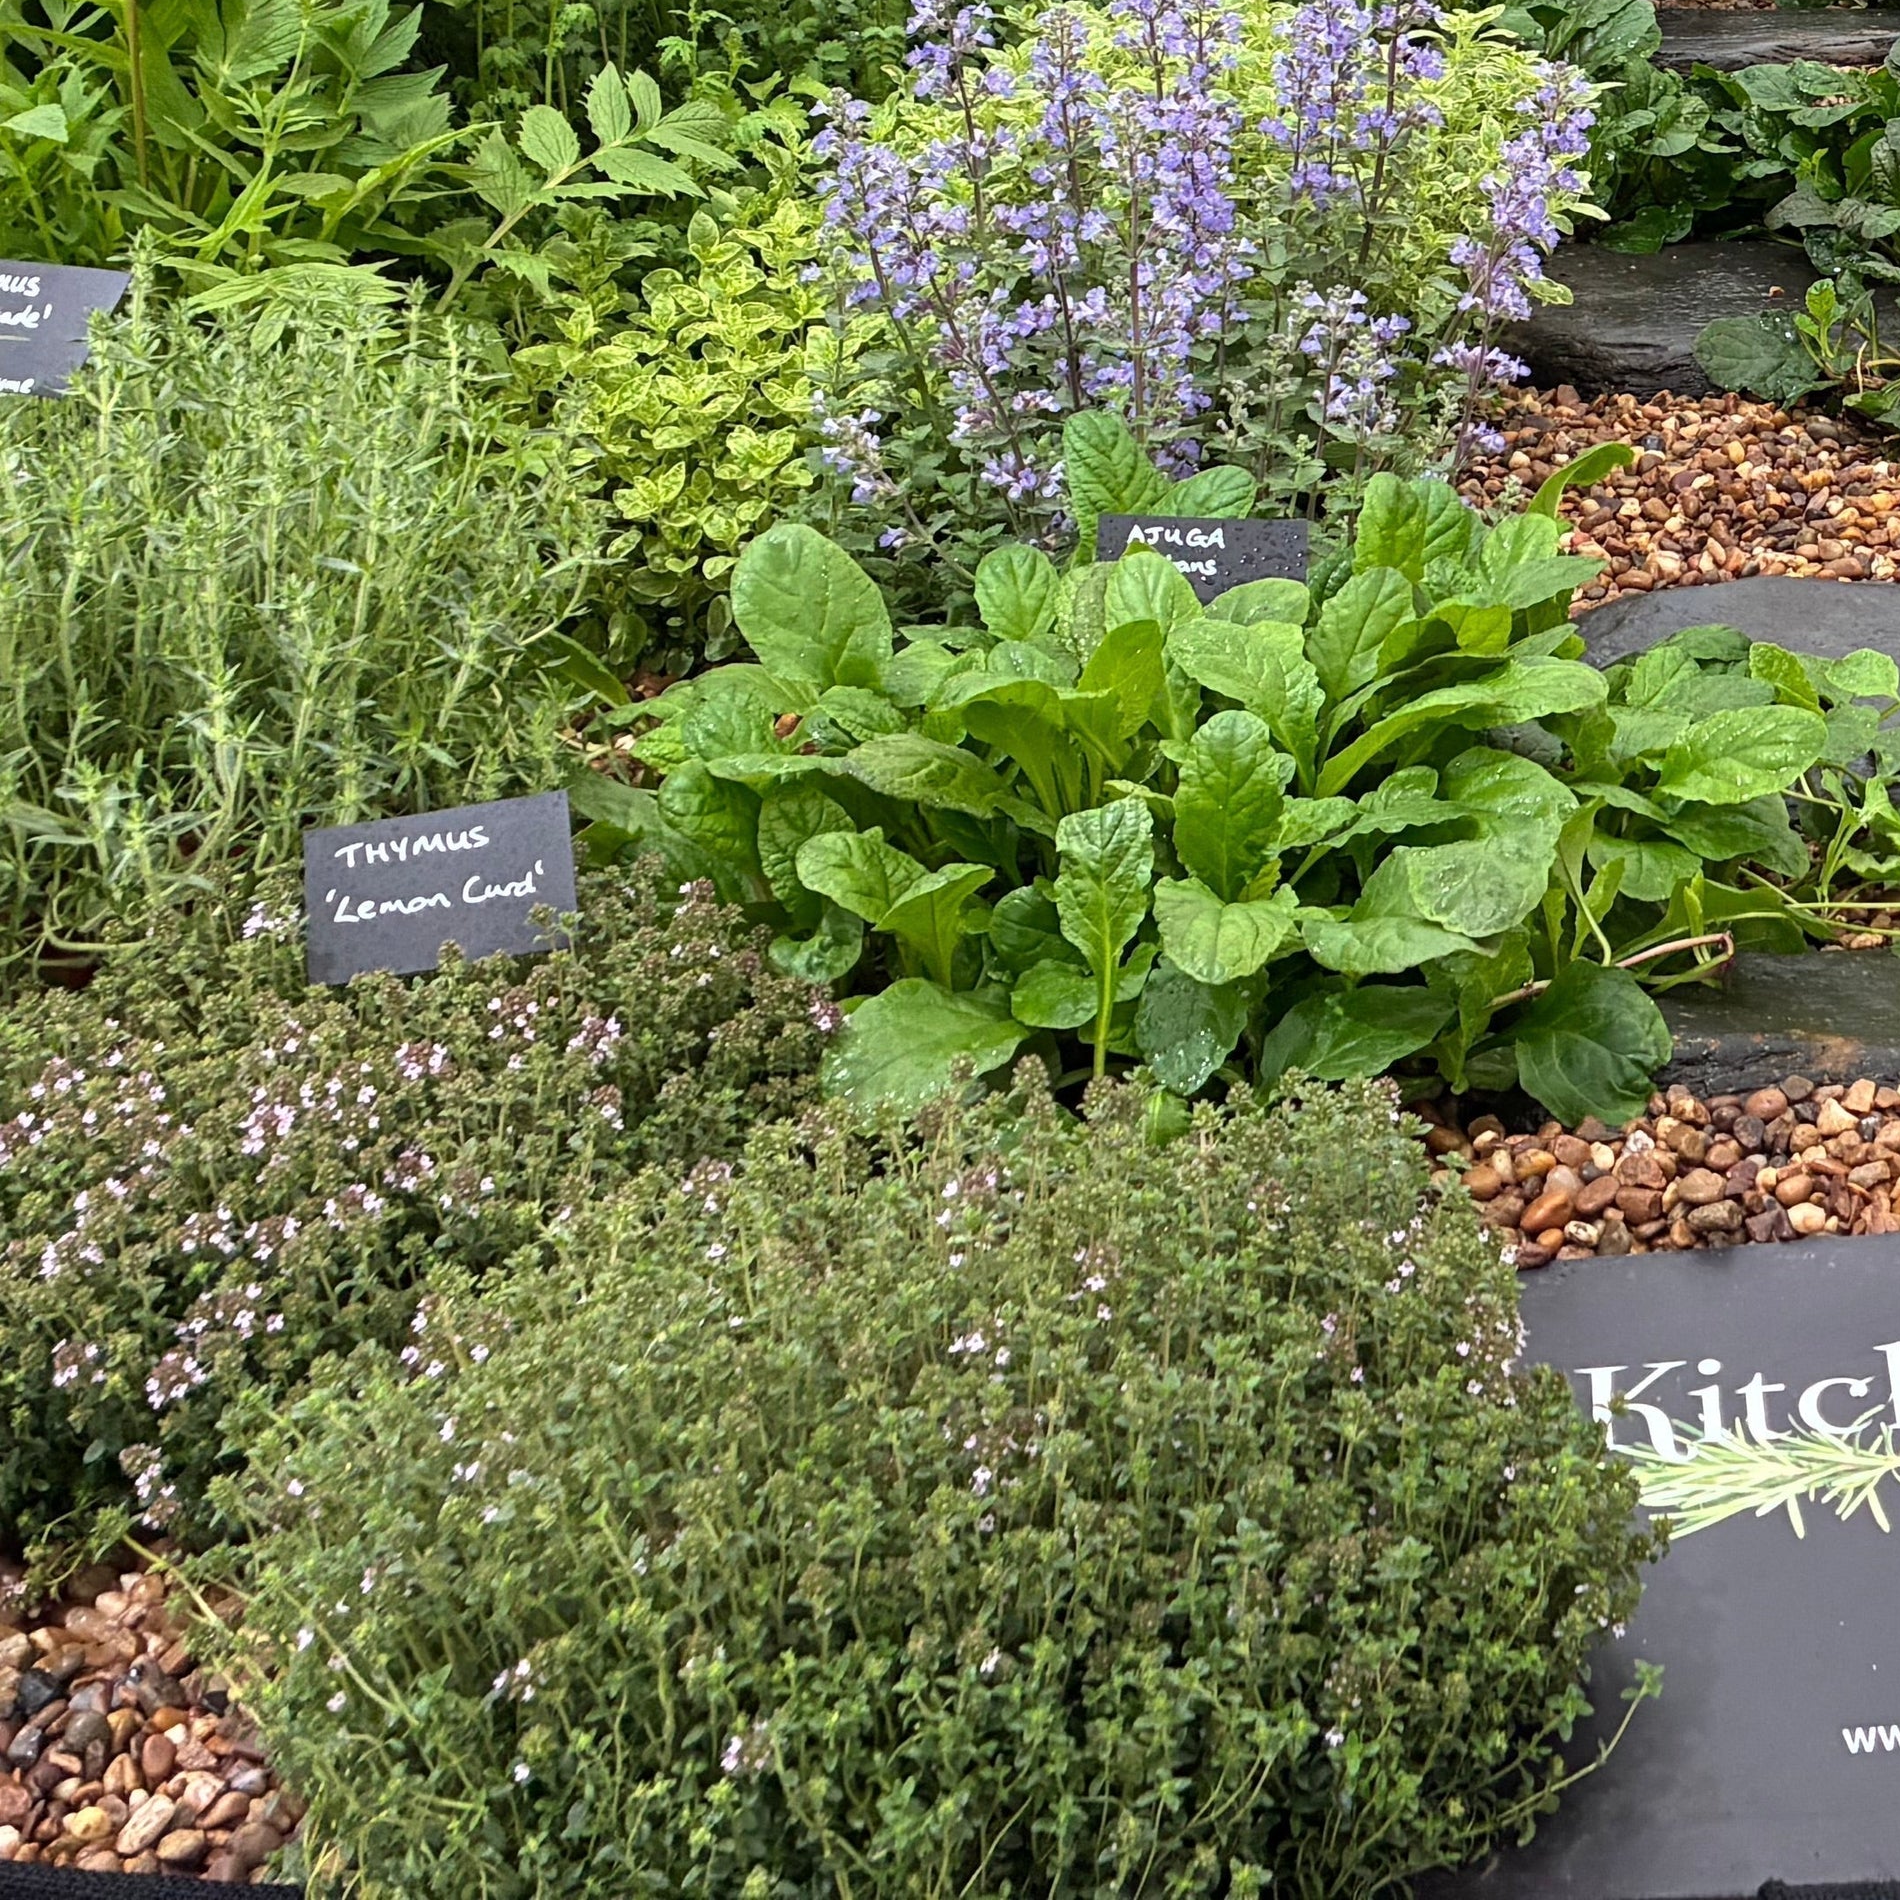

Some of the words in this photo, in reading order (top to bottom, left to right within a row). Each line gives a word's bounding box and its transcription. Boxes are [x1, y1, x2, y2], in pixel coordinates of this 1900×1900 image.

[1126, 524, 1226, 549] AJUGA
[334, 825, 490, 868] THYMUS
[325, 888, 452, 923] 'Lemon
